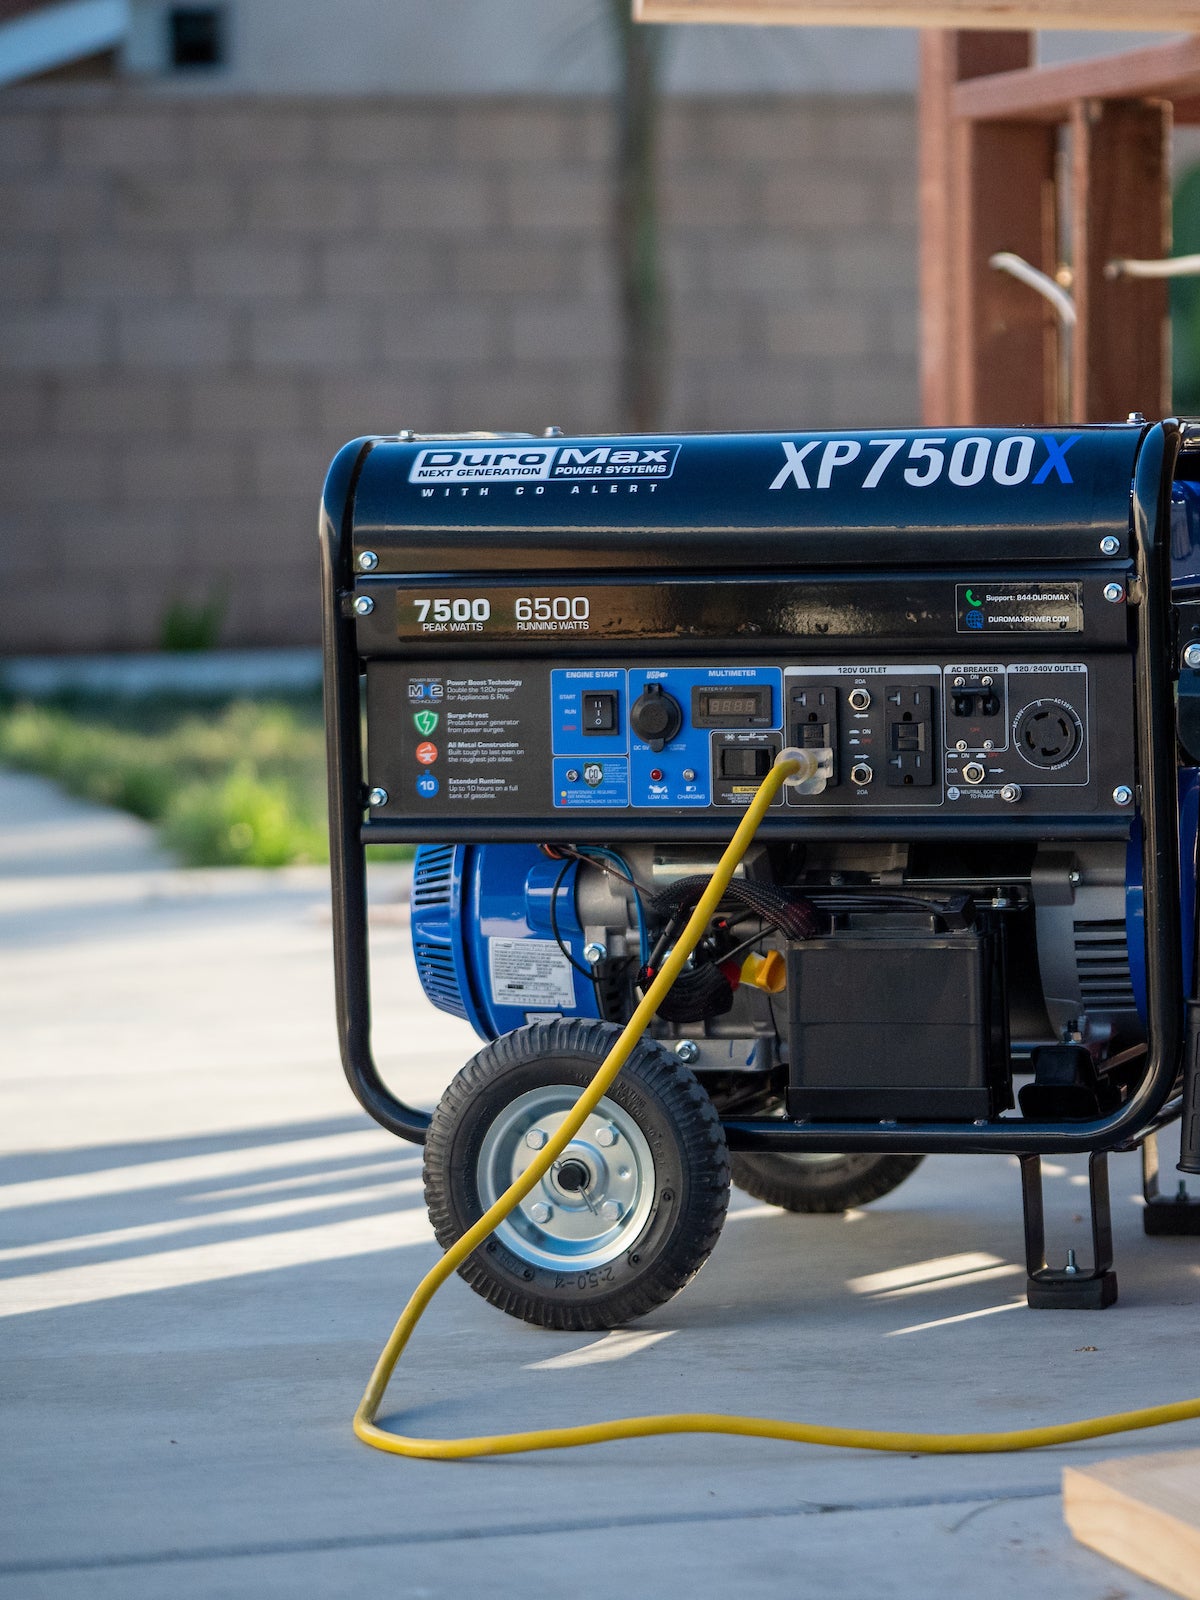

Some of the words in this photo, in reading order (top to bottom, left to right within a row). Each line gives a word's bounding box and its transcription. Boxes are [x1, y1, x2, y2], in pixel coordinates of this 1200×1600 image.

[769, 435, 1083, 490] XP7500X
[456, 468, 541, 476] GENERATION
[555, 466, 602, 475] POWER
[605, 465, 666, 474] SYSTEMS
[422, 488, 489, 497] WITH
[516, 486, 544, 495] CO
[571, 484, 658, 494] ALERT
[986, 594, 1015, 602] Support:
[414, 598, 491, 622] 7500
[515, 596, 590, 621] 6500
[422, 623, 448, 632] PEAK
[450, 622, 484, 631] WATTS
[517, 622, 558, 630] RUNNING
[559, 621, 589, 630] WATTS
[588, 769, 598, 779] CO
[420, 781, 435, 790] 10
